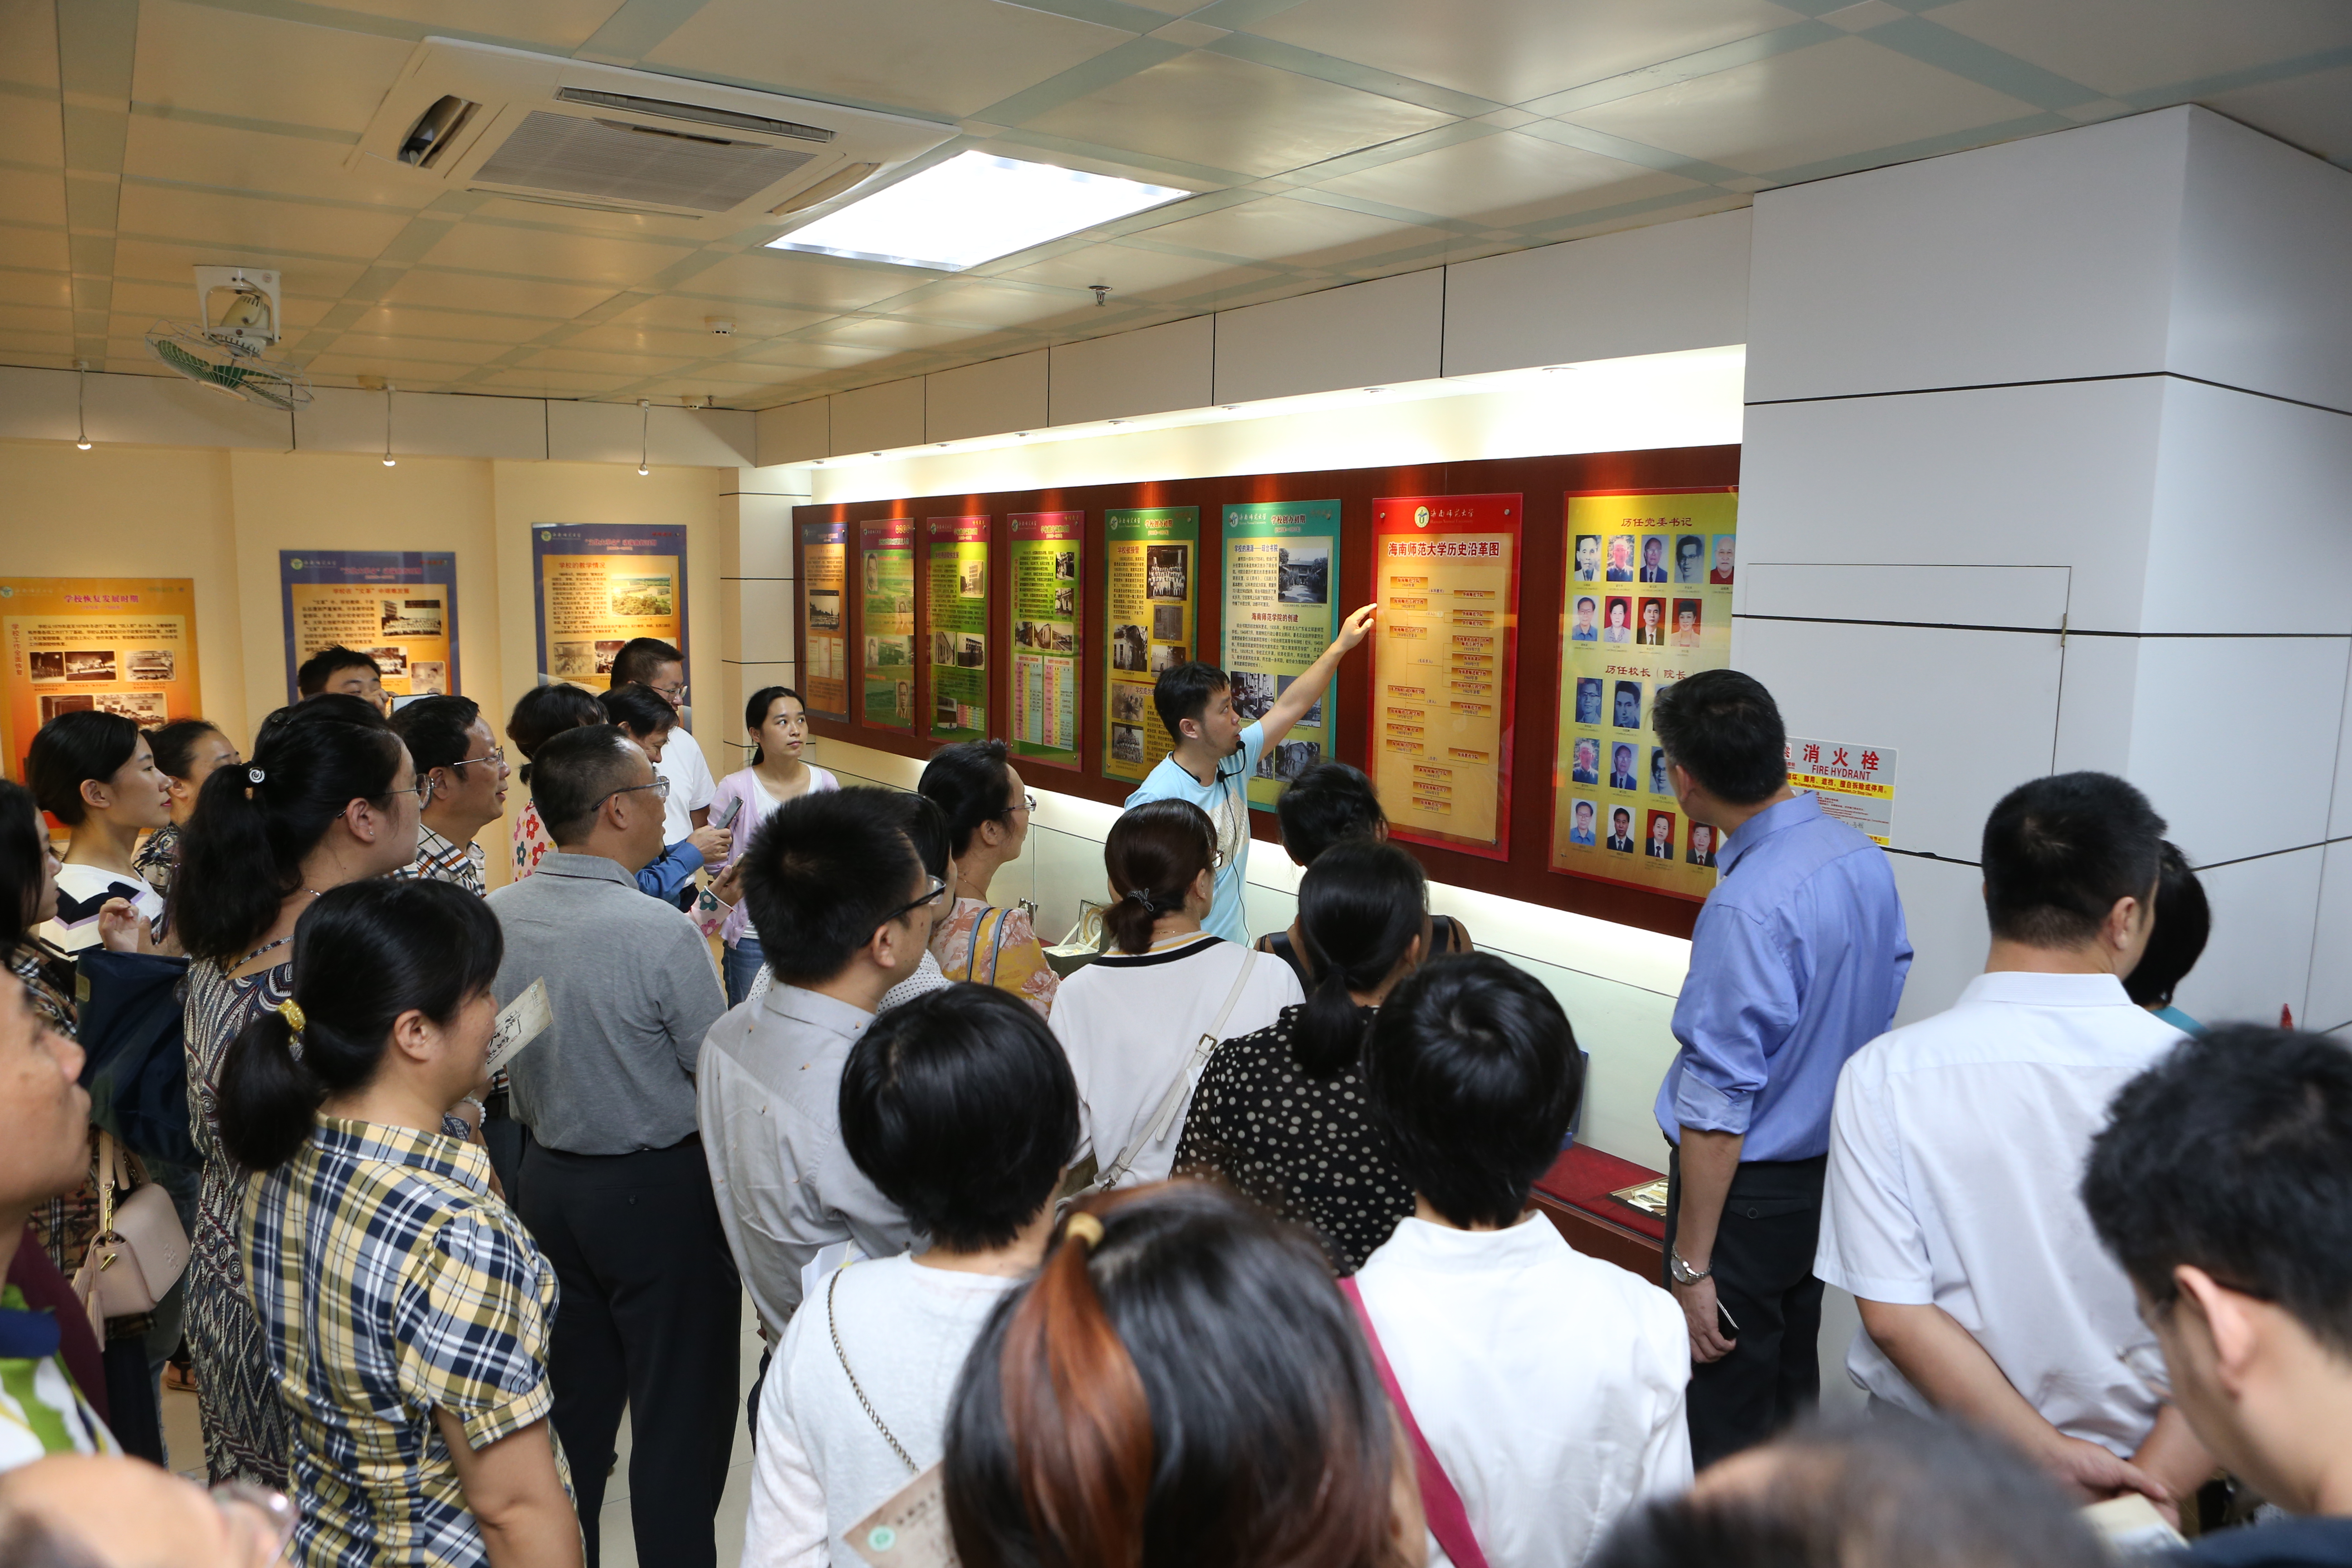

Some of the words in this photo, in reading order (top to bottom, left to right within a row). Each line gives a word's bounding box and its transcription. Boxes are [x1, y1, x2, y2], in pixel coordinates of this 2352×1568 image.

[1145, 519, 1173, 529] 学校创办初期
[1271, 514, 1306, 524] 学校创办初期
[1621, 517, 1693, 528] 历任党委书记
[1117, 546, 1140, 554] 学校被接管
[1388, 542, 1499, 557] 海南师范大学历史沿革图
[64, 595, 139, 603] 学校恢复发展时期
[1251, 612, 1298, 622] 海南师范学院的创建
[1803, 744, 1880, 771] 消火栓
[1812, 764, 1829, 775] FIRE
[1831, 767, 1871, 780] HYDRANT
